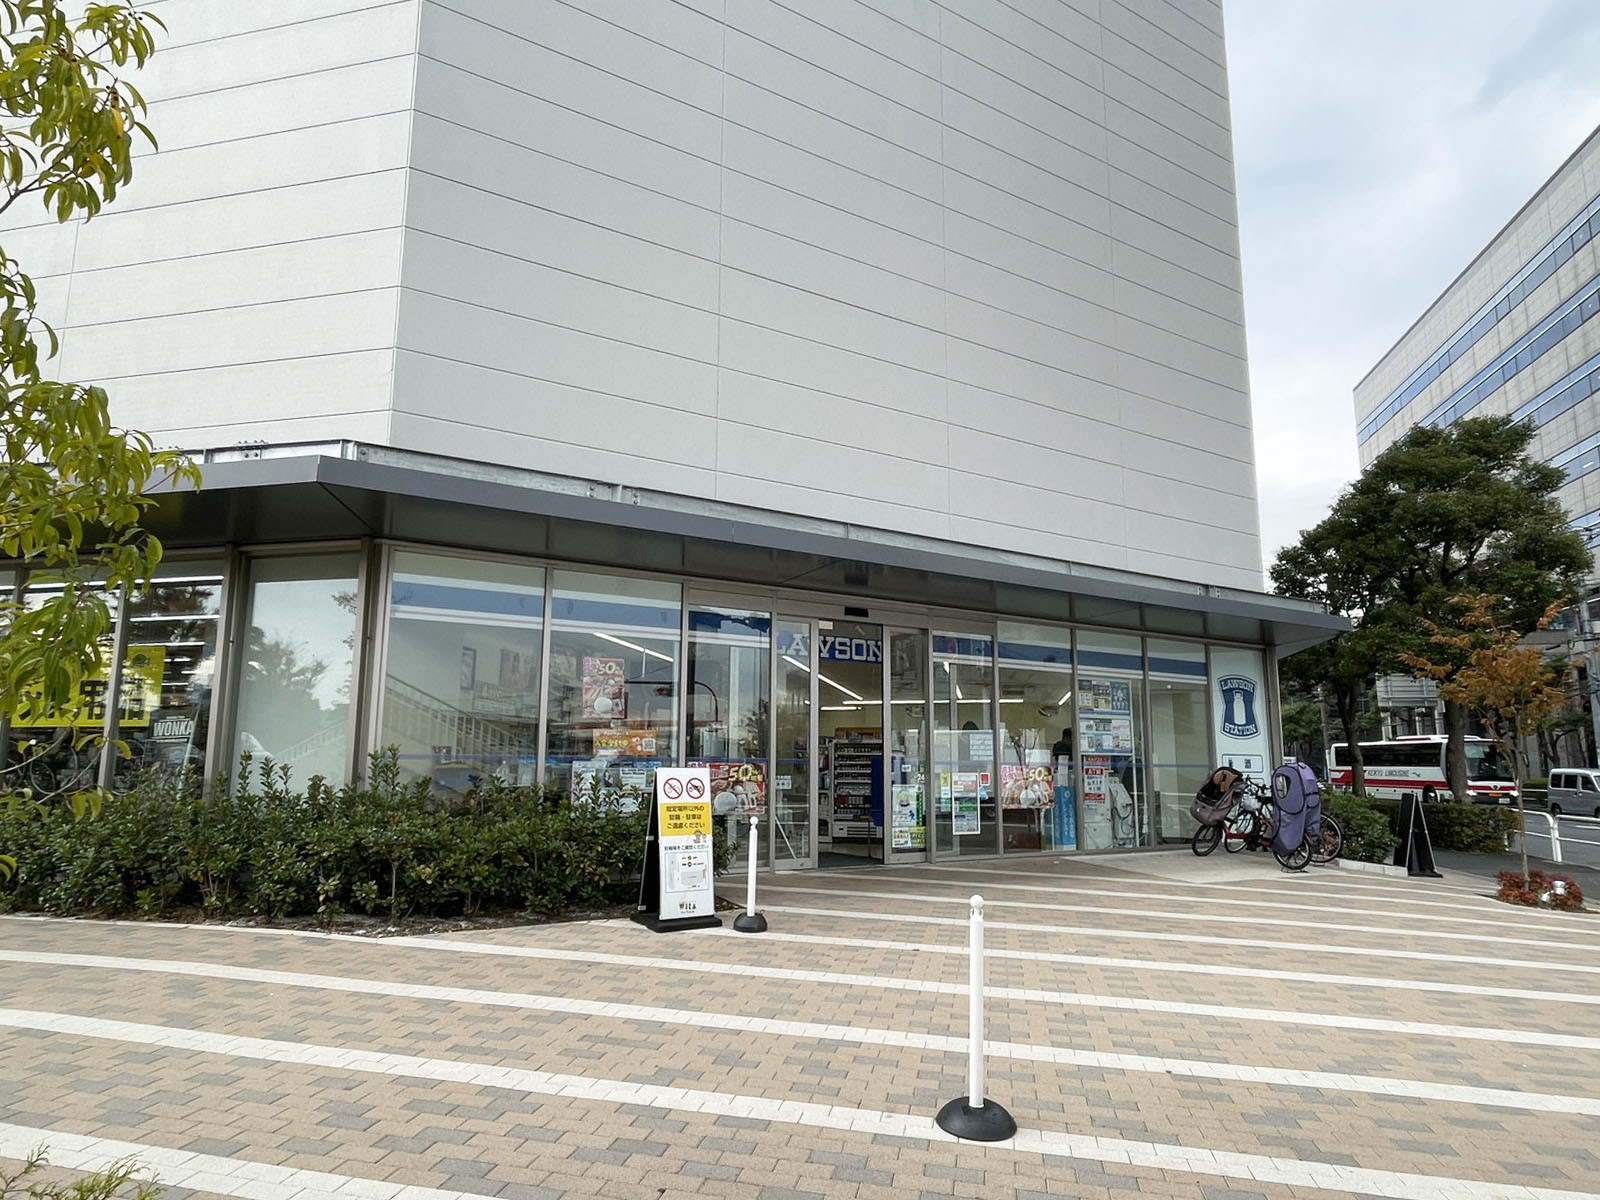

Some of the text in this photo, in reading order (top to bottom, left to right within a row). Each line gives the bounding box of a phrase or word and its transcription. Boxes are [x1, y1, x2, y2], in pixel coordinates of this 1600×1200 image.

[1221, 680, 1254, 692] LAWSON
[154, 720, 194, 736] WONKA
[1225, 723, 1256, 735] STATION
